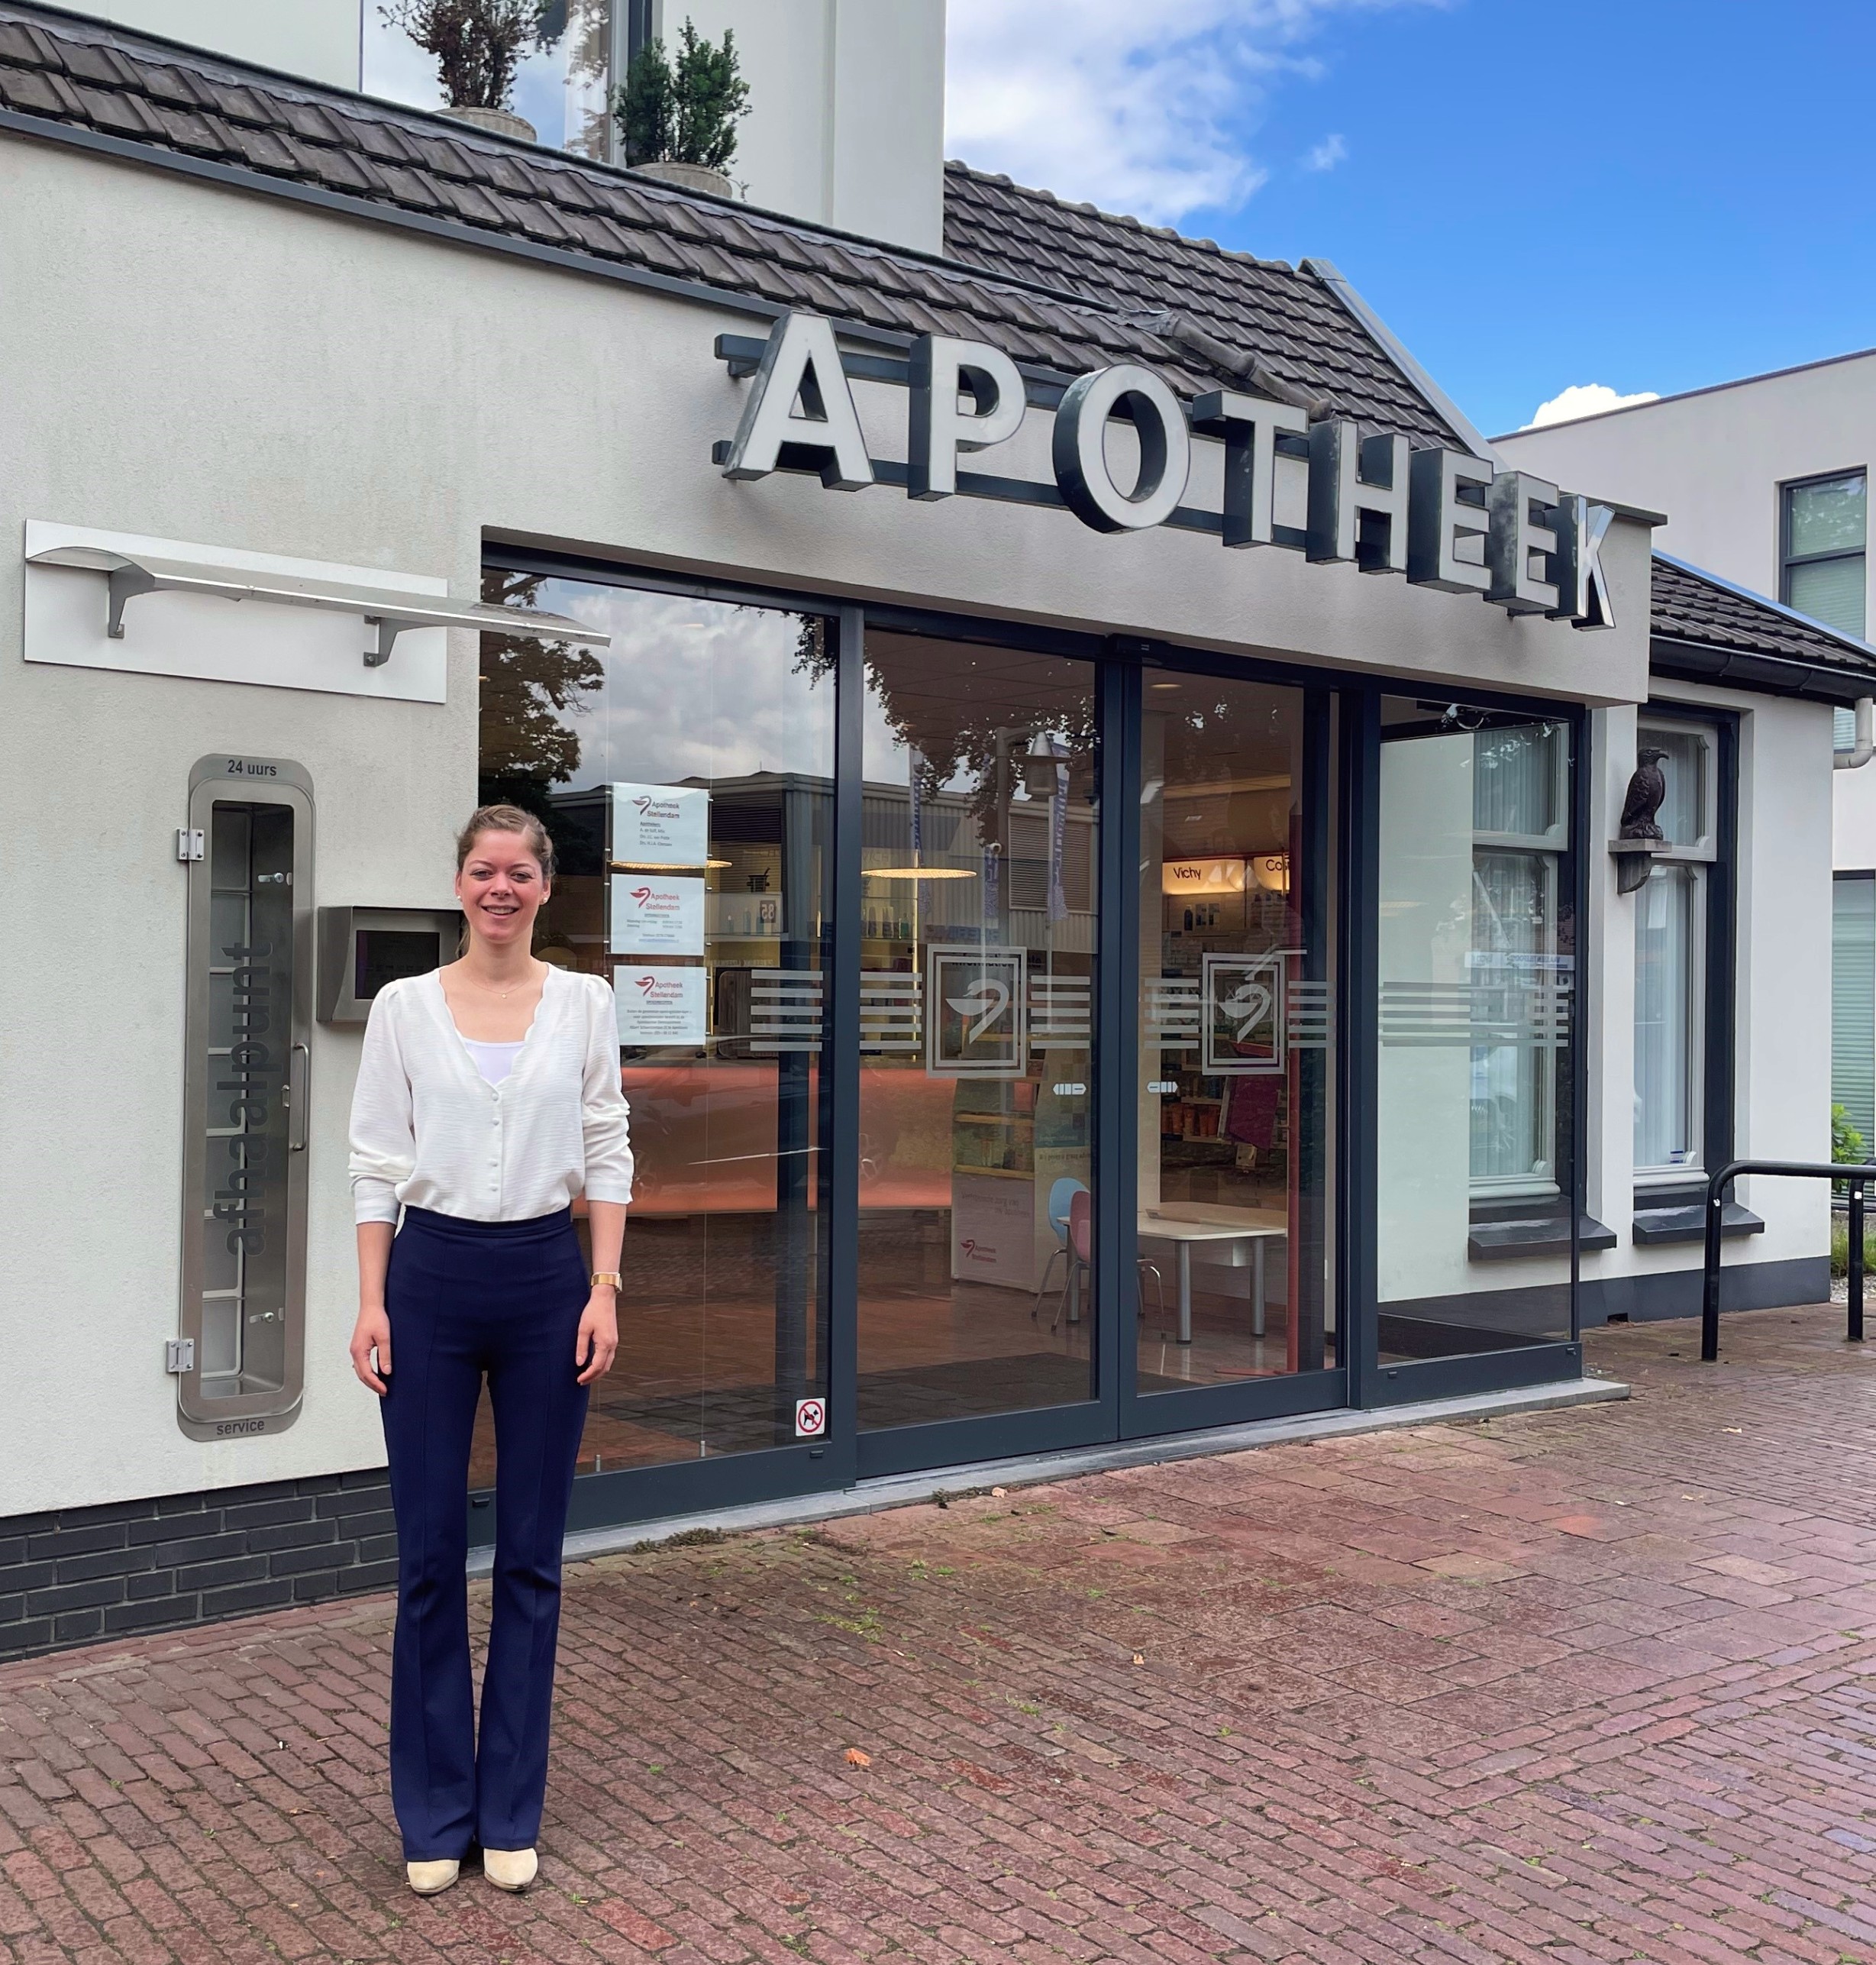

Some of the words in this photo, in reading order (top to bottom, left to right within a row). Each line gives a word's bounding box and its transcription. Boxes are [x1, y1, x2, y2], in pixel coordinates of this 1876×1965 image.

[722, 310, 1616, 631] APOTHEEK
[228, 759, 243, 774] 24
[247, 764, 276, 776] uurs
[652, 800, 680, 810] Apotheek
[1173, 866, 1201, 880] Vichy
[651, 893, 680, 901] Apotheek
[213, 942, 283, 1257] afhaalpunt
[216, 1418, 265, 1436] service
